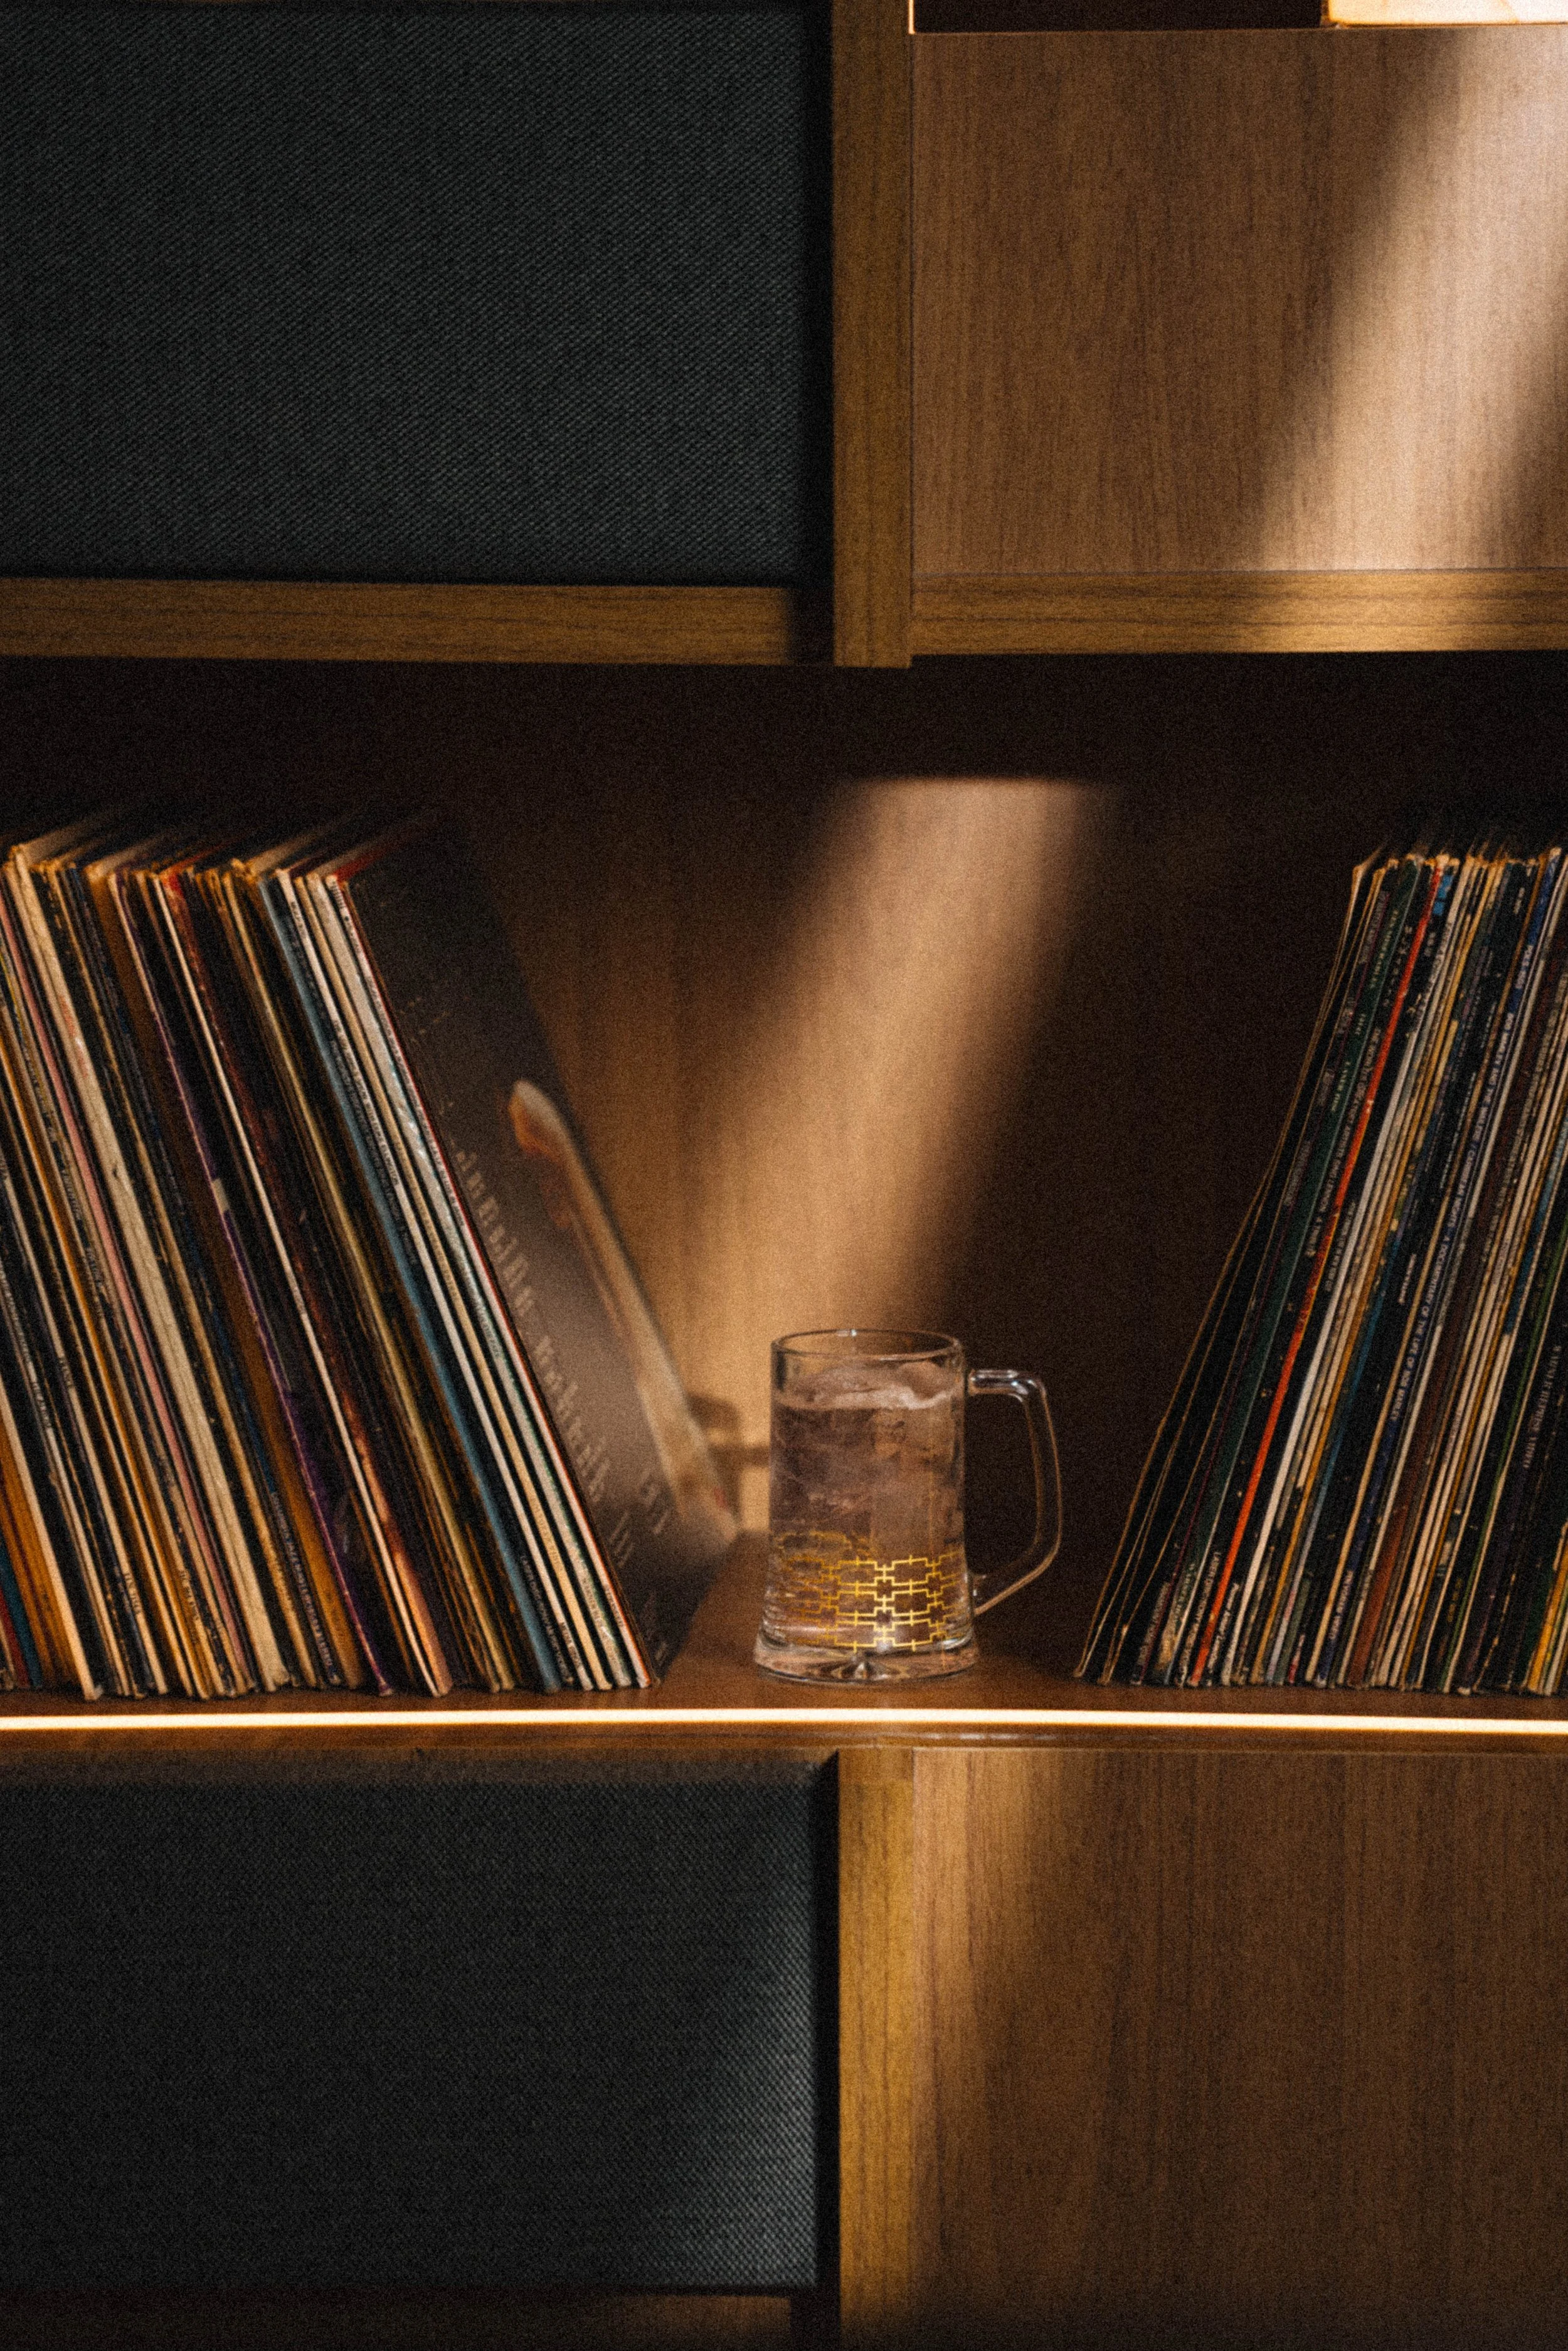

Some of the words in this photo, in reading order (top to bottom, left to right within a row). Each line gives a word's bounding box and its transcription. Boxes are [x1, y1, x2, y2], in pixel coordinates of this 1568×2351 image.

[1502, 1011, 1516, 1030] BOB
[1493, 1031, 1511, 1066] MARLEY
[1488, 1066, 1500, 1085] AND
[1481, 1086, 1494, 1103] THE
[1471, 1105, 1488, 1142] WAILERS
[378, 1144, 400, 1186] ELLINGTON
[1456, 1148, 1476, 1196] CARIBBEAN
[1446, 1195, 1464, 1228] NIGHTS
[1423, 1242, 1449, 1304] DOCUMENTARY
[1414, 1318, 1427, 1336] THE
[1419, 1304, 1431, 1318] OF
[1404, 1355, 1416, 1368] OF
[1408, 1336, 1421, 1354] LIFE
[1399, 1369, 1412, 1387] BOB
[1540, 1343, 1564, 1389] WARNER
[1388, 1387, 1406, 1421] MARLEY
[1528, 1389, 1551, 1433] REPRISE
[1518, 1434, 1539, 1469] VIDEO
[1207, 1551, 1222, 1578] LASER
[1333, 1569, 1357, 1615] POLYGRAM
[1325, 1613, 1343, 1642] VIDEO
